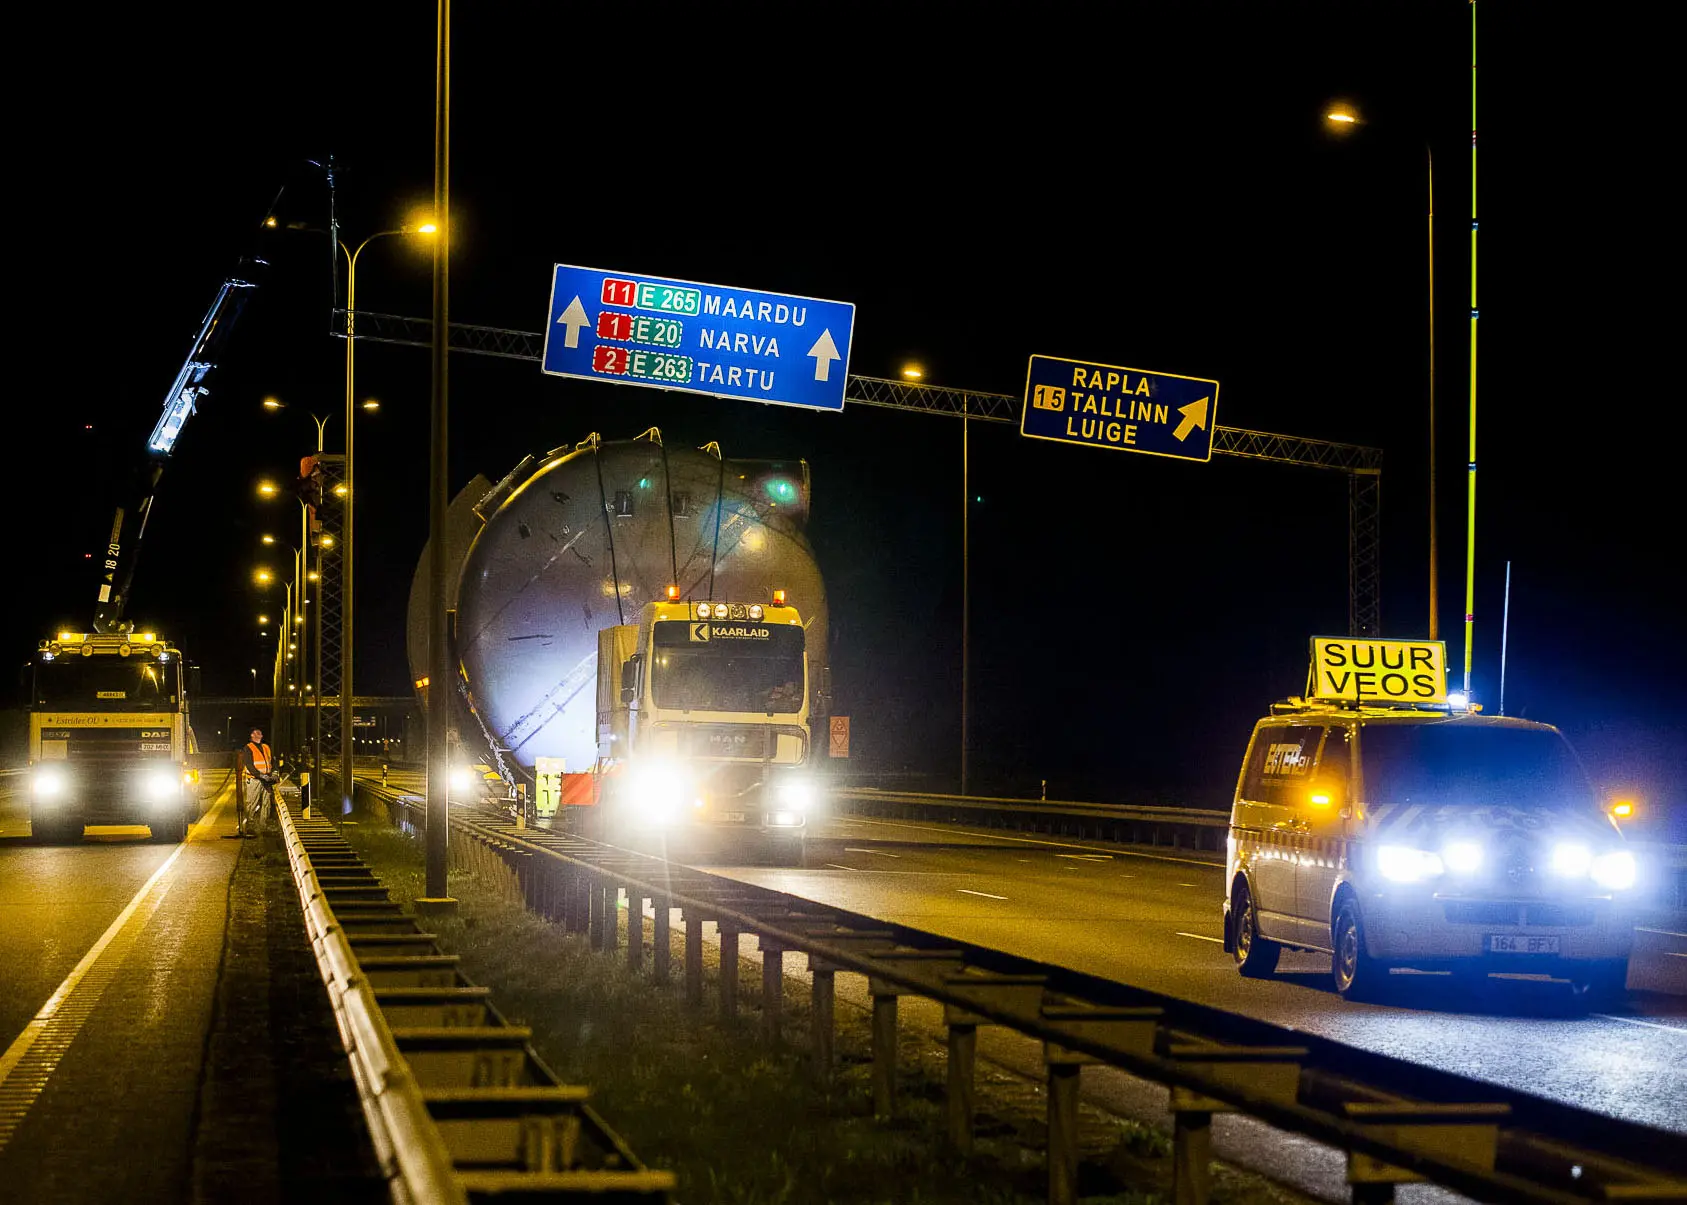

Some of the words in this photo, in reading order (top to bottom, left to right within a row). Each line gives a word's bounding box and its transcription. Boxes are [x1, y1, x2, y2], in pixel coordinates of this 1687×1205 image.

[606, 283, 632, 304] 11
[642, 287, 656, 306] E
[662, 289, 697, 312] 265
[703, 294, 807, 327] MAARDU
[610, 317, 619, 336] 1
[636, 319, 650, 339] E
[654, 322, 678, 344] 20
[699, 328, 780, 358] NARVA
[605, 351, 616, 370] 2
[632, 353, 647, 374] E
[652, 356, 688, 380] 263
[697, 362, 775, 391] TARTU
[1072, 367, 1150, 396] RAPLA
[1037, 388, 1062, 408] 15
[1071, 391, 1168, 425] TALLINN
[1066, 416, 1138, 445] LUIGE
[105, 559, 116, 569] 18
[108, 543, 120, 556] 20
[712, 627, 770, 637] KAARLAID
[1323, 642, 1436, 671] SUUR
[1325, 670, 1437, 698] VEOS
[710, 735, 746, 744] MAN
